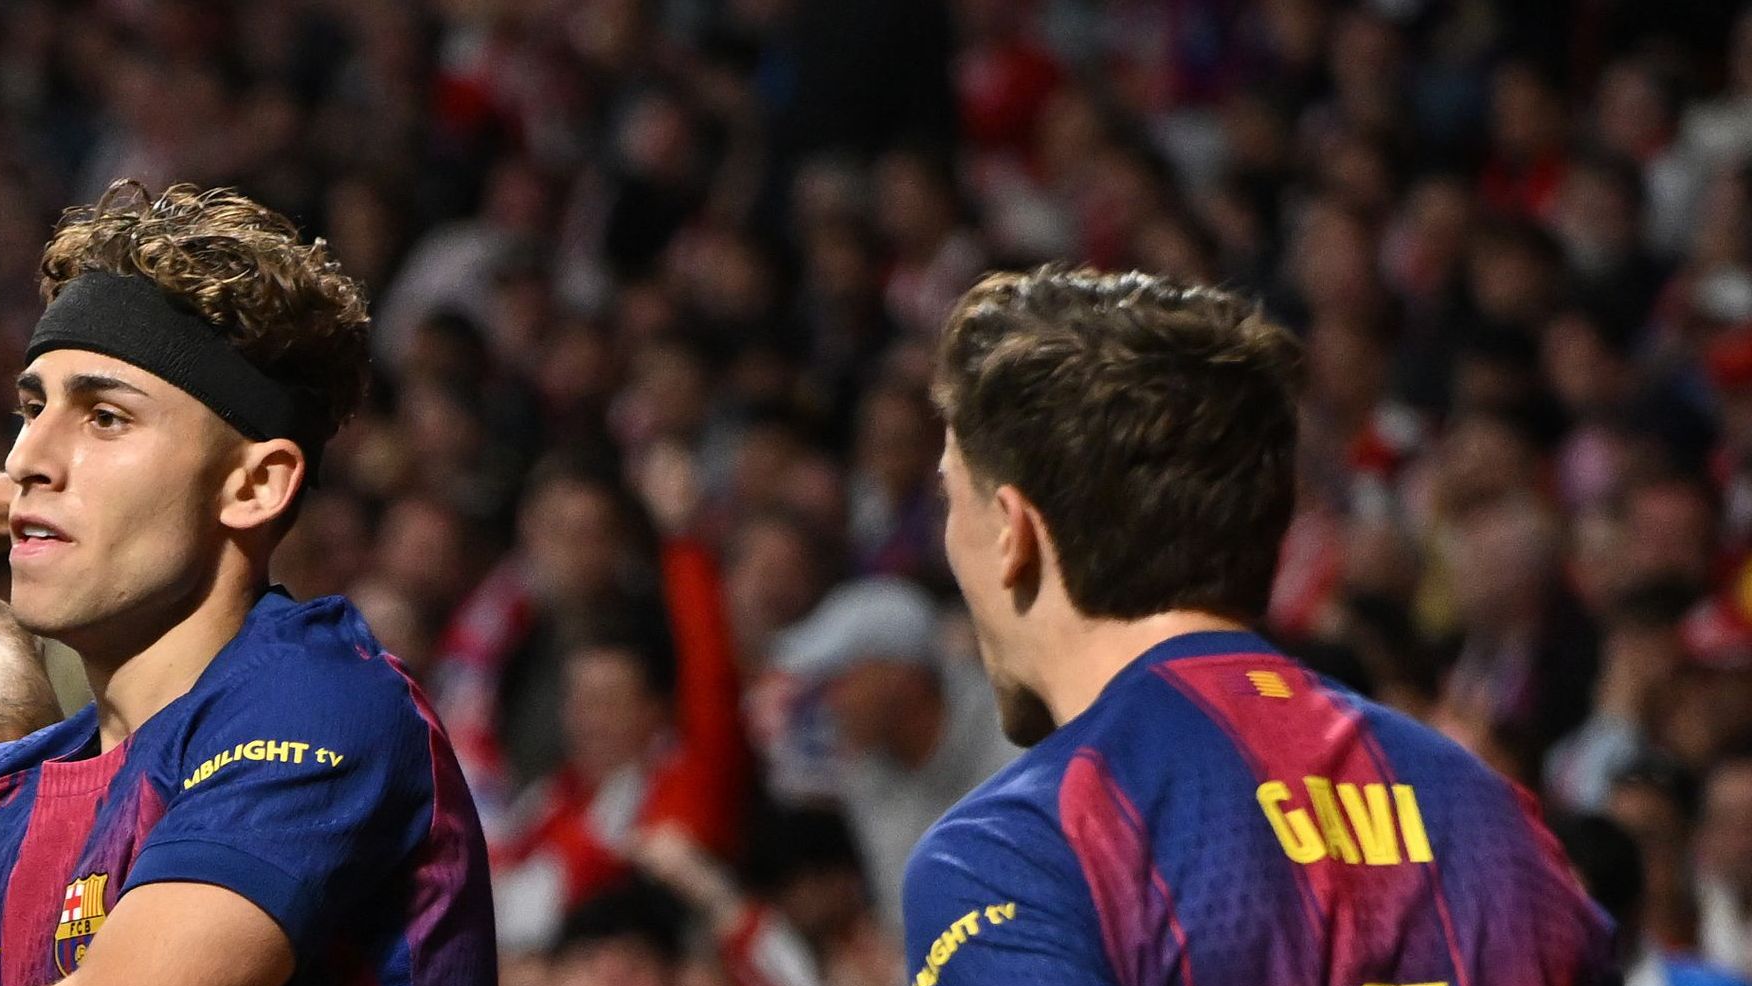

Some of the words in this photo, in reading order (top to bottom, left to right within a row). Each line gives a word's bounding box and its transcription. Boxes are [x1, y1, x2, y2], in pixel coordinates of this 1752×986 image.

[183, 740, 310, 790] MBILIGHT
[314, 747, 345, 768] tv
[1256, 775, 1434, 865] GAVI
[69, 919, 92, 937] FCB
